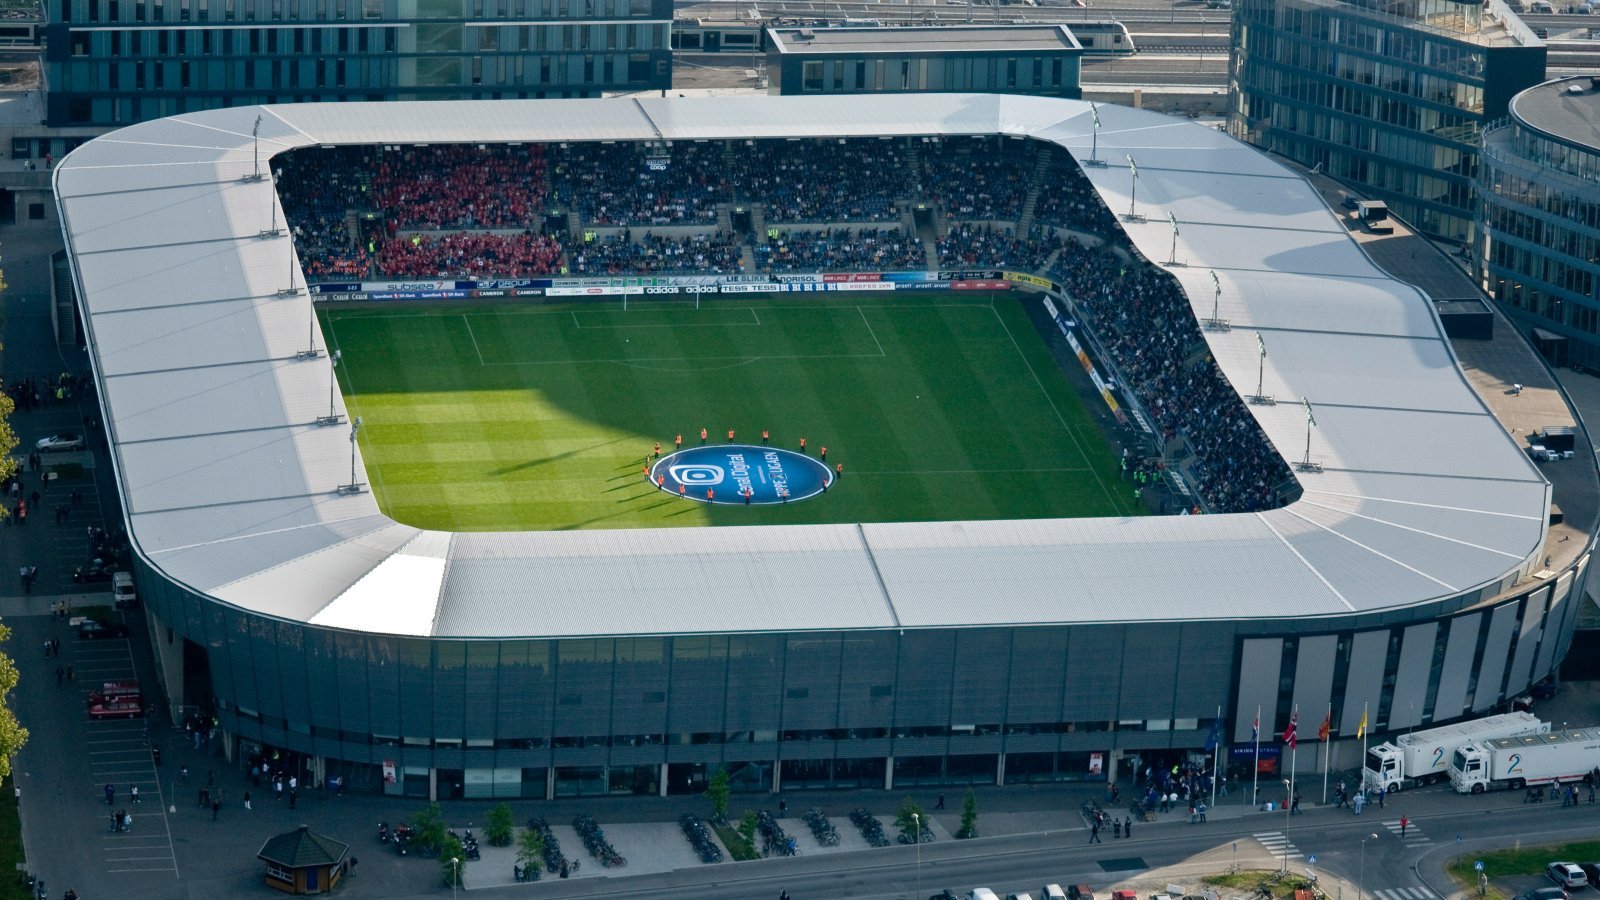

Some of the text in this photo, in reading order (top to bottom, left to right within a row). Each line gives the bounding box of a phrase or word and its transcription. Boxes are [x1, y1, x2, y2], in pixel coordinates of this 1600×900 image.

[387, 282, 444, 291] subsea 7
[647, 286, 679, 294] adidas
[686, 285, 718, 293] adidas
[726, 454, 754, 496] Canal Digital
